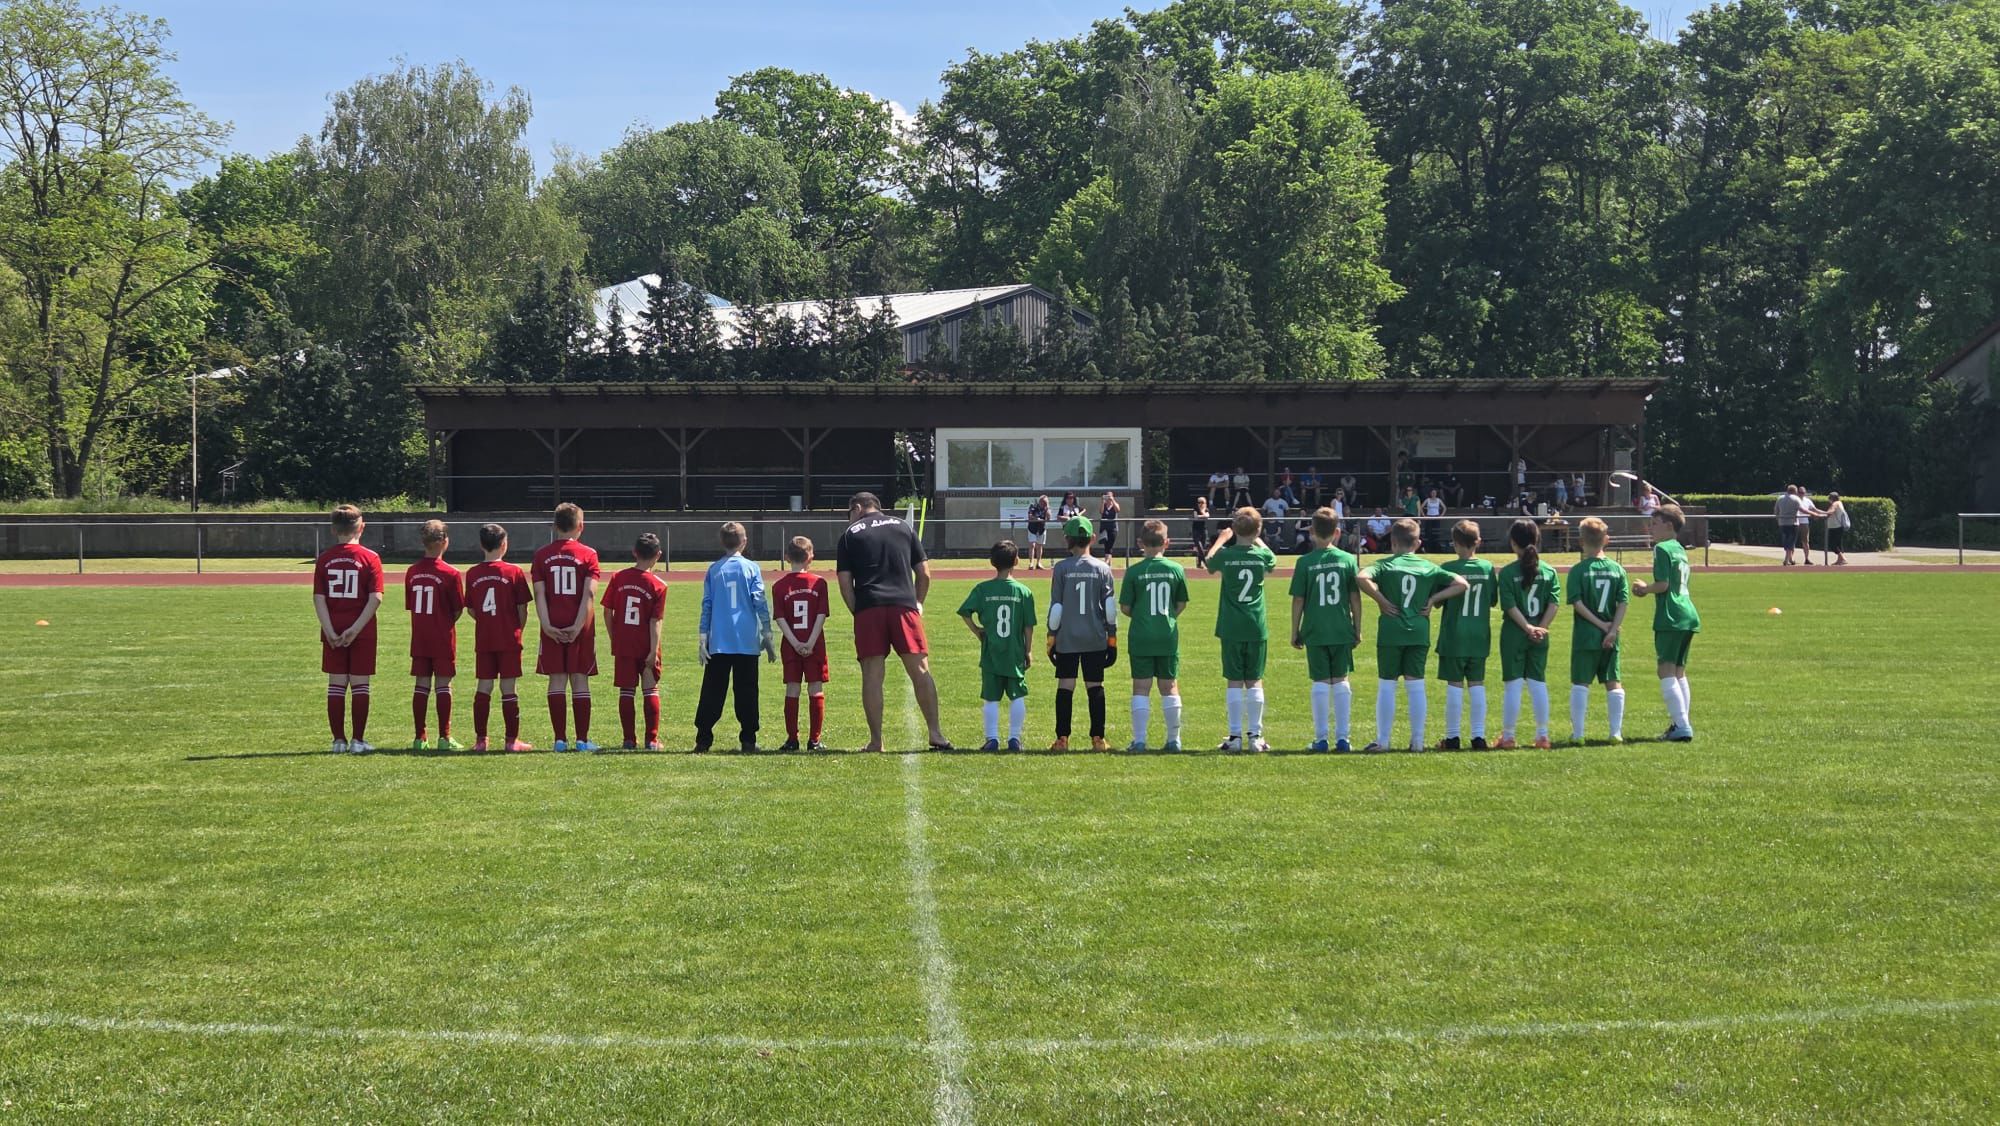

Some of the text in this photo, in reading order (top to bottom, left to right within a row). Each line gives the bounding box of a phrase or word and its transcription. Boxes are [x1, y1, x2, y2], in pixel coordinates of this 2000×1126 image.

[327, 569, 359, 599] 20
[550, 565, 577, 595] 10
[726, 580, 737, 609] 1
[1238, 568, 1254, 603] 2
[1316, 571, 1341, 607] 13
[1401, 574, 1417, 609] 9
[1595, 579, 1611, 613] 7
[412, 584, 434, 615] 11
[482, 587, 497, 616] 4
[624, 595, 641, 626] 6
[793, 600, 809, 630] 9
[1075, 581, 1086, 615] 1
[1145, 581, 1171, 616] 10
[1462, 583, 1483, 617] 11
[1527, 583, 1540, 617] 6
[996, 604, 1011, 638] 8
